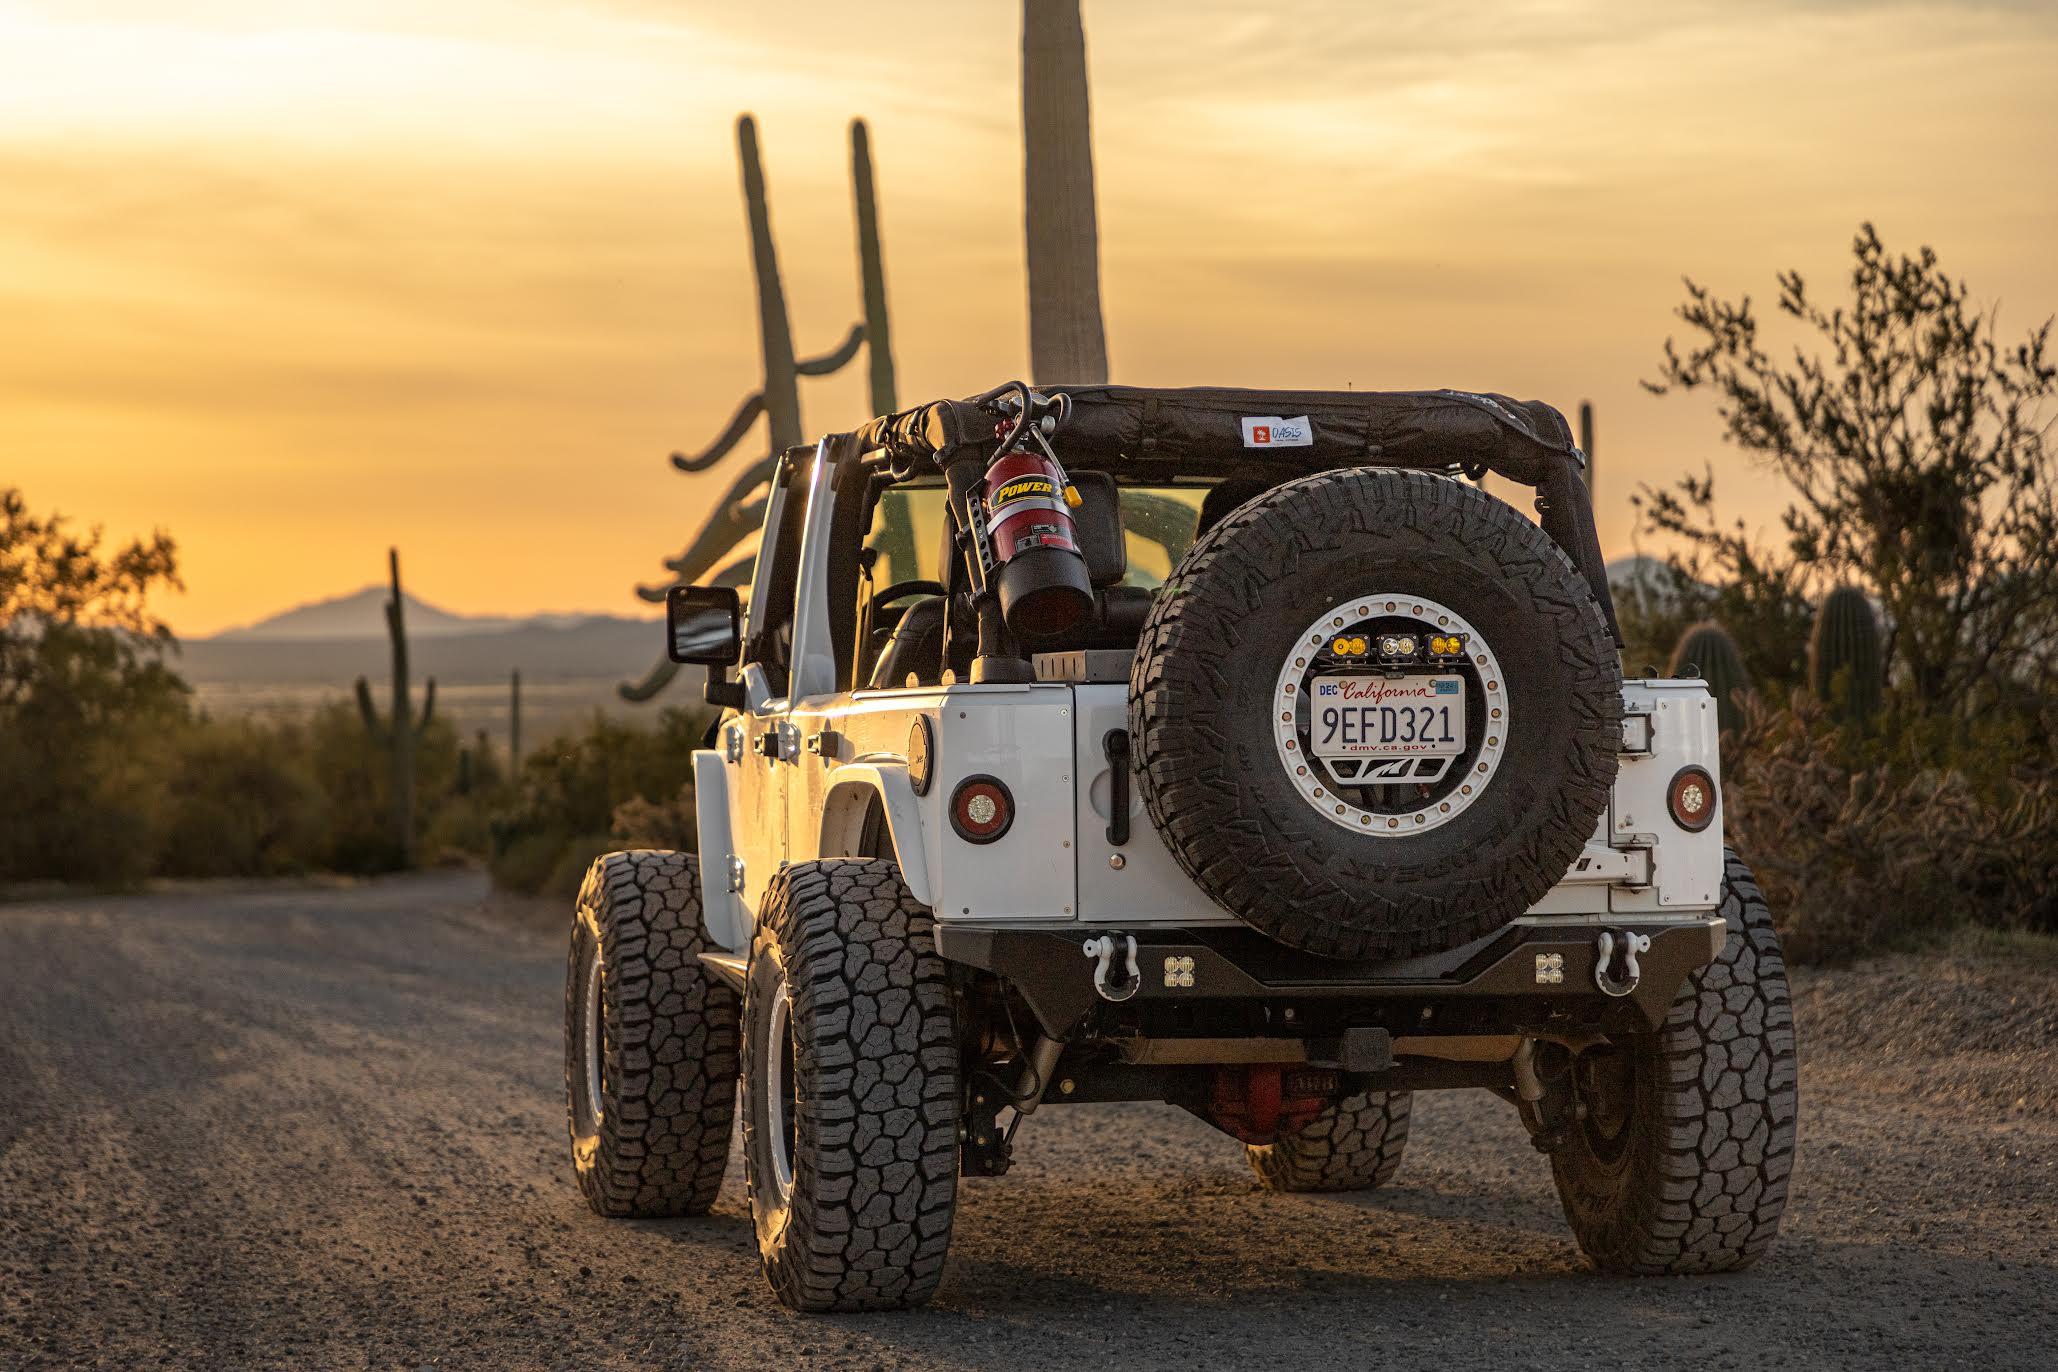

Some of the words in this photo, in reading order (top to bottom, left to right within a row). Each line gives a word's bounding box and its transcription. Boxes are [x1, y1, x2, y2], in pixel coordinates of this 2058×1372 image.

[1272, 426, 1302, 439] OASIS
[997, 481, 1053, 504] POWER
[1319, 684, 1338, 696] DEC
[1343, 681, 1437, 704] California
[1322, 706, 1455, 744] 9EFD321
